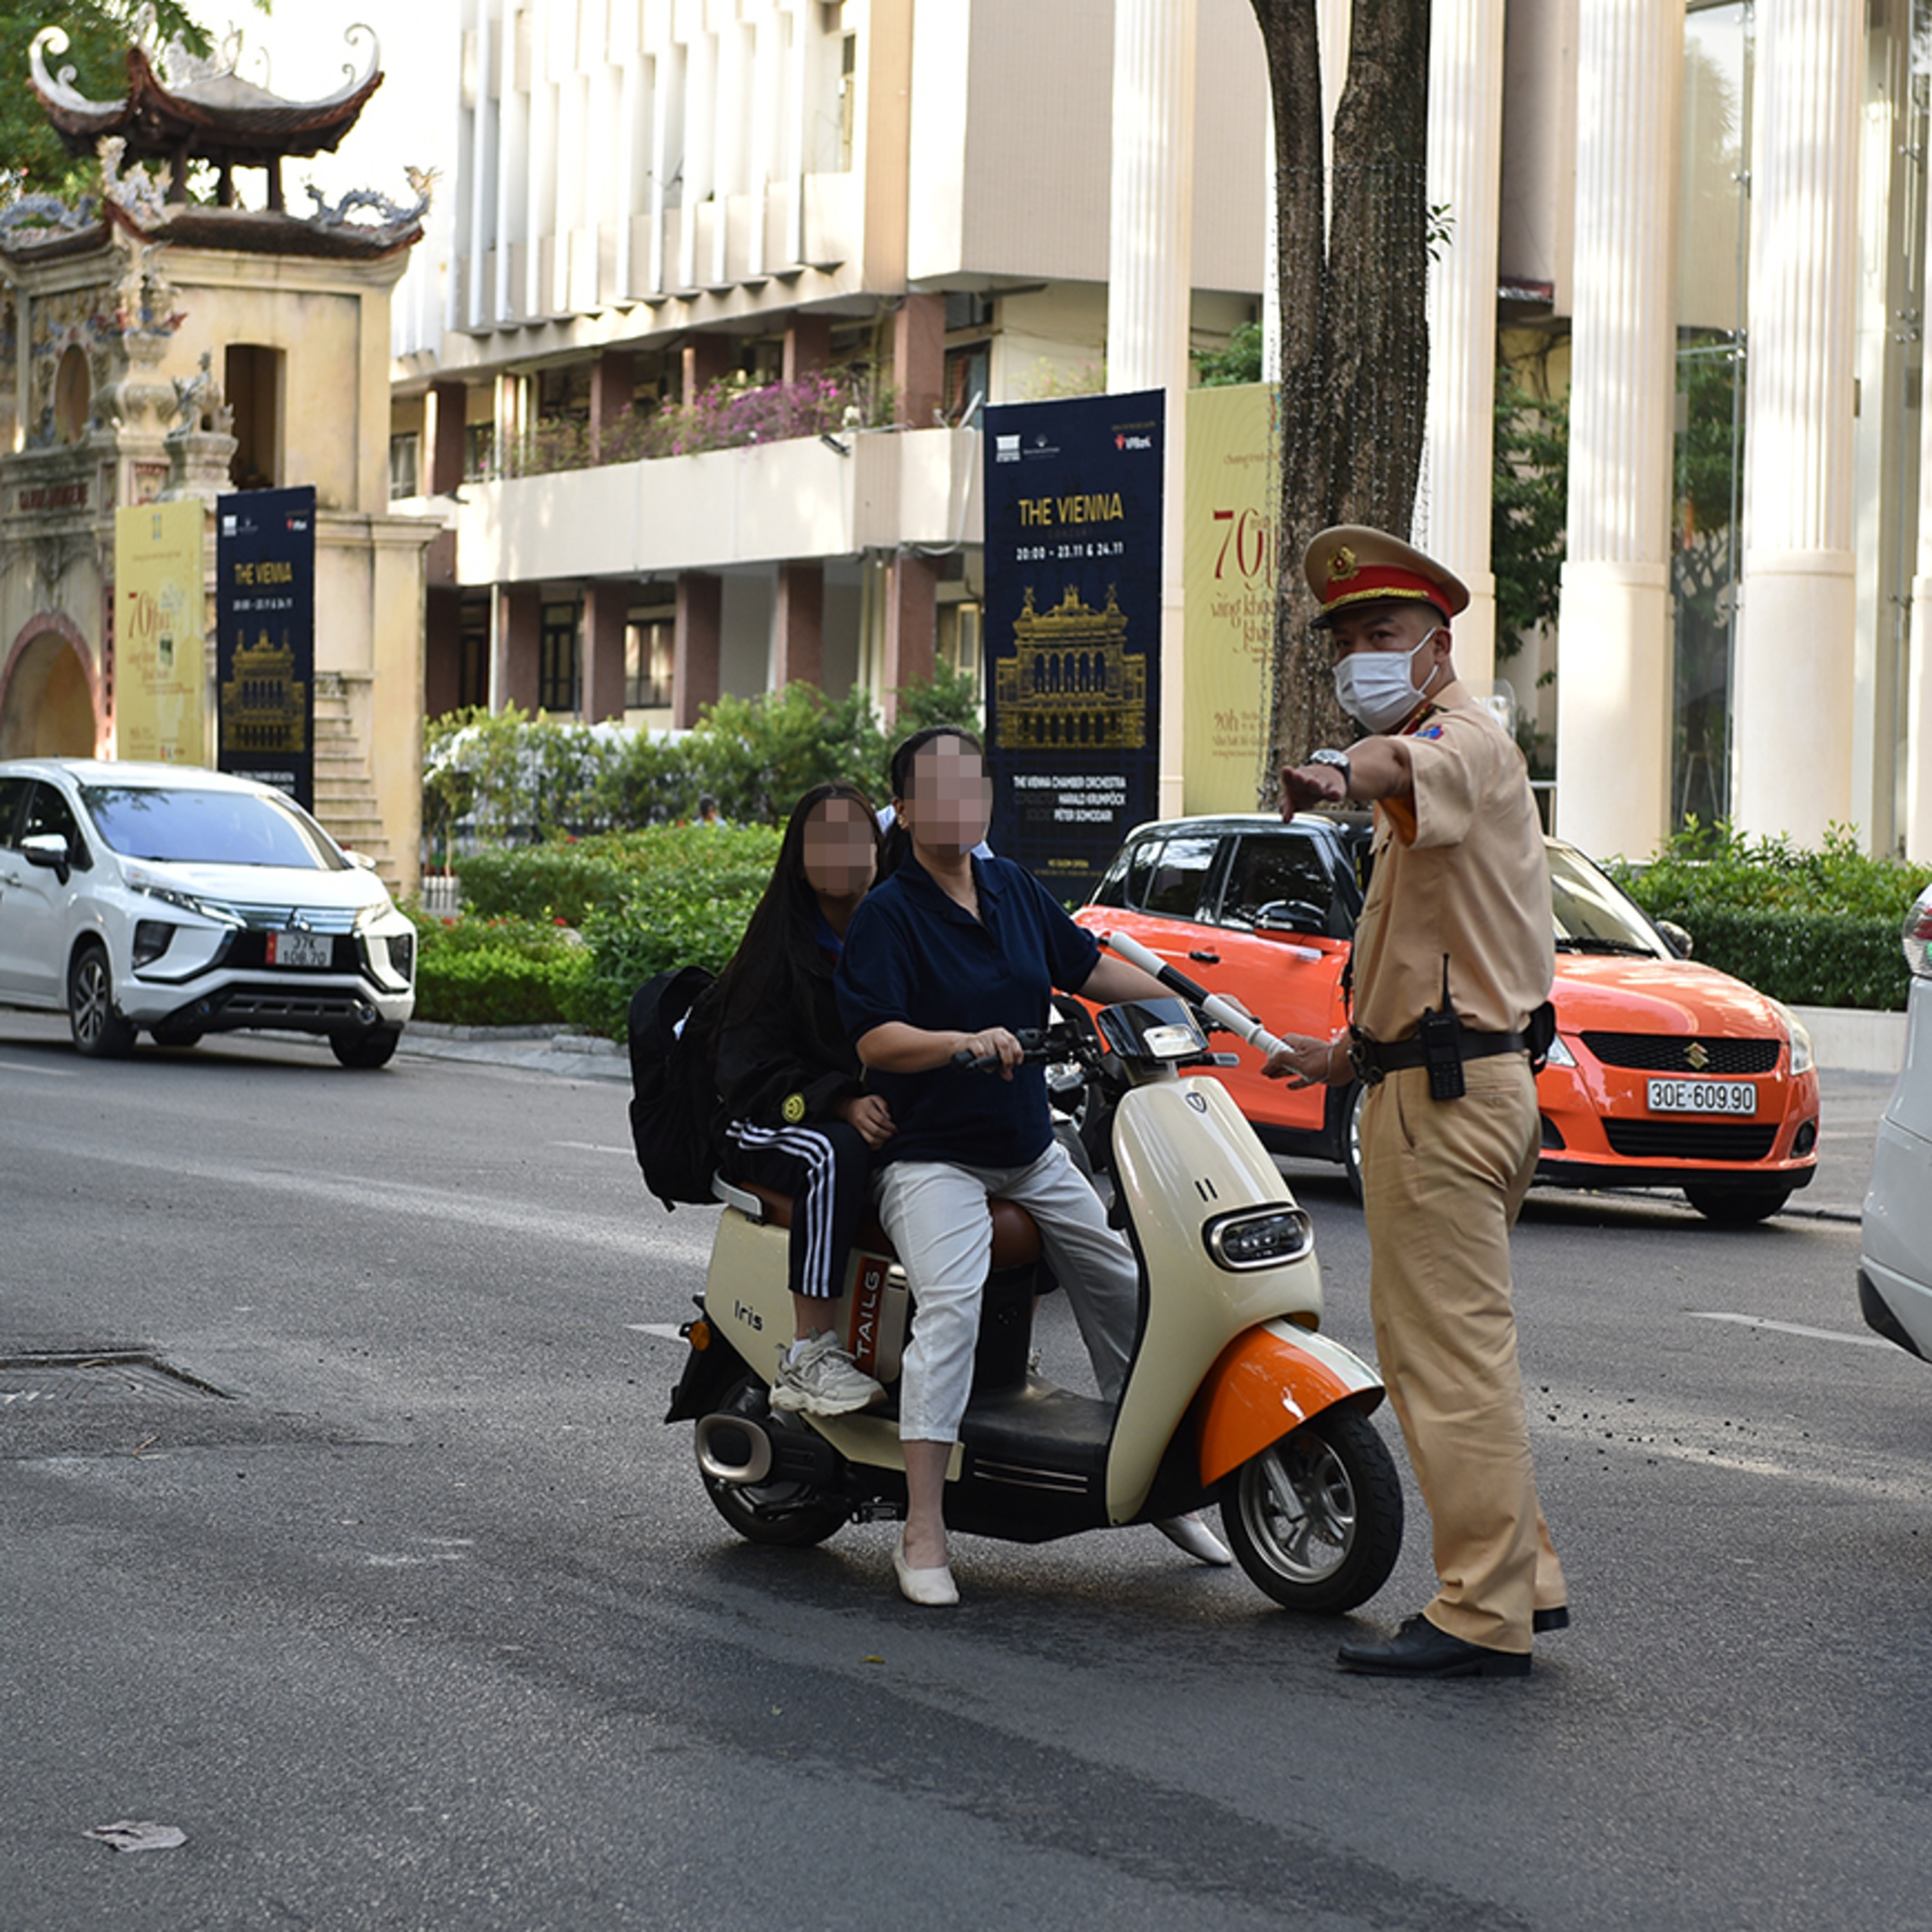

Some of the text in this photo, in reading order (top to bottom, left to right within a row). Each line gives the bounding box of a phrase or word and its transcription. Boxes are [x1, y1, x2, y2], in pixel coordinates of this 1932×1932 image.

[1018, 493, 1124, 526] THE VIENNA
[1016, 546, 1046, 561] 20:00
[1058, 544, 1083, 558] 23.11
[1097, 541, 1123, 556] 24.11
[1213, 507, 1264, 579] 70
[234, 561, 292, 585] THE VIENNA
[1014, 776, 1027, 788] THE
[734, 1300, 763, 1331] Iris
[855, 1270, 880, 1358] TAILG
